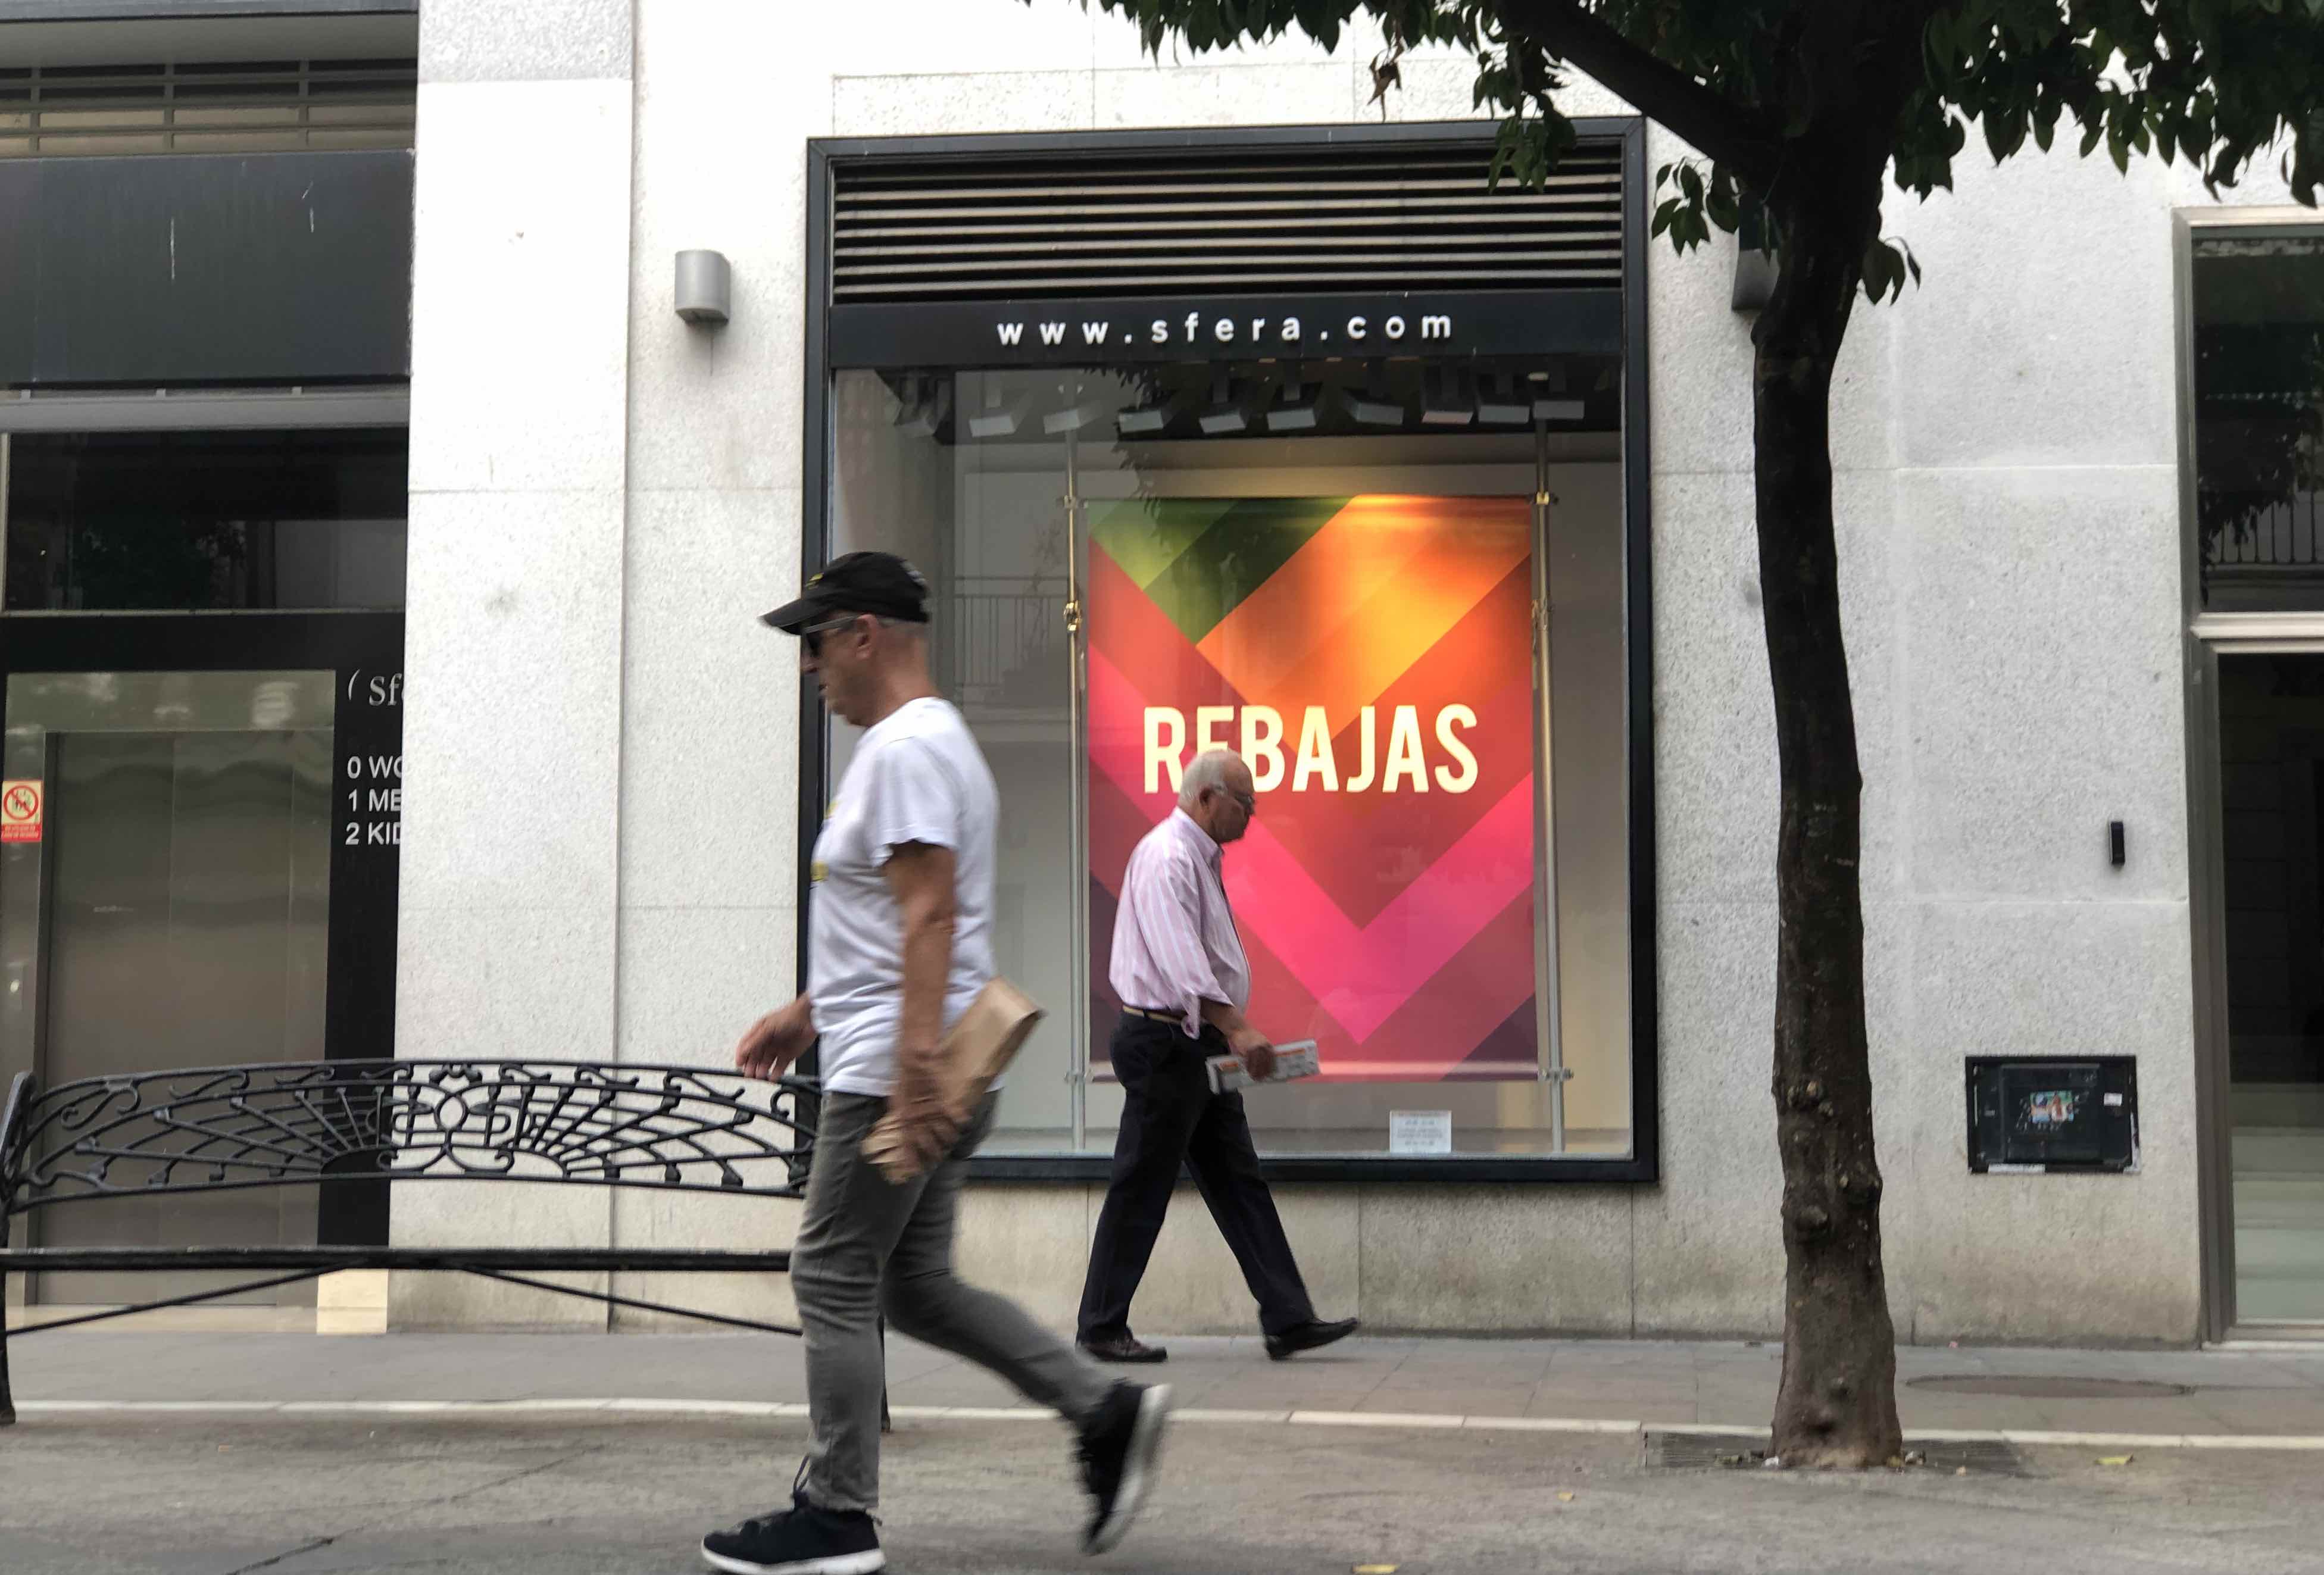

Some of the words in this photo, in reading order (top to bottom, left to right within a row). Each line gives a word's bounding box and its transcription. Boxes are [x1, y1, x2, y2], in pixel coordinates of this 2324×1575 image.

[997, 311, 1452, 345] www.sfera.com
[368, 673, 404, 706] Sf
[348, 789, 357, 812] 1
[345, 821, 360, 845] 2
